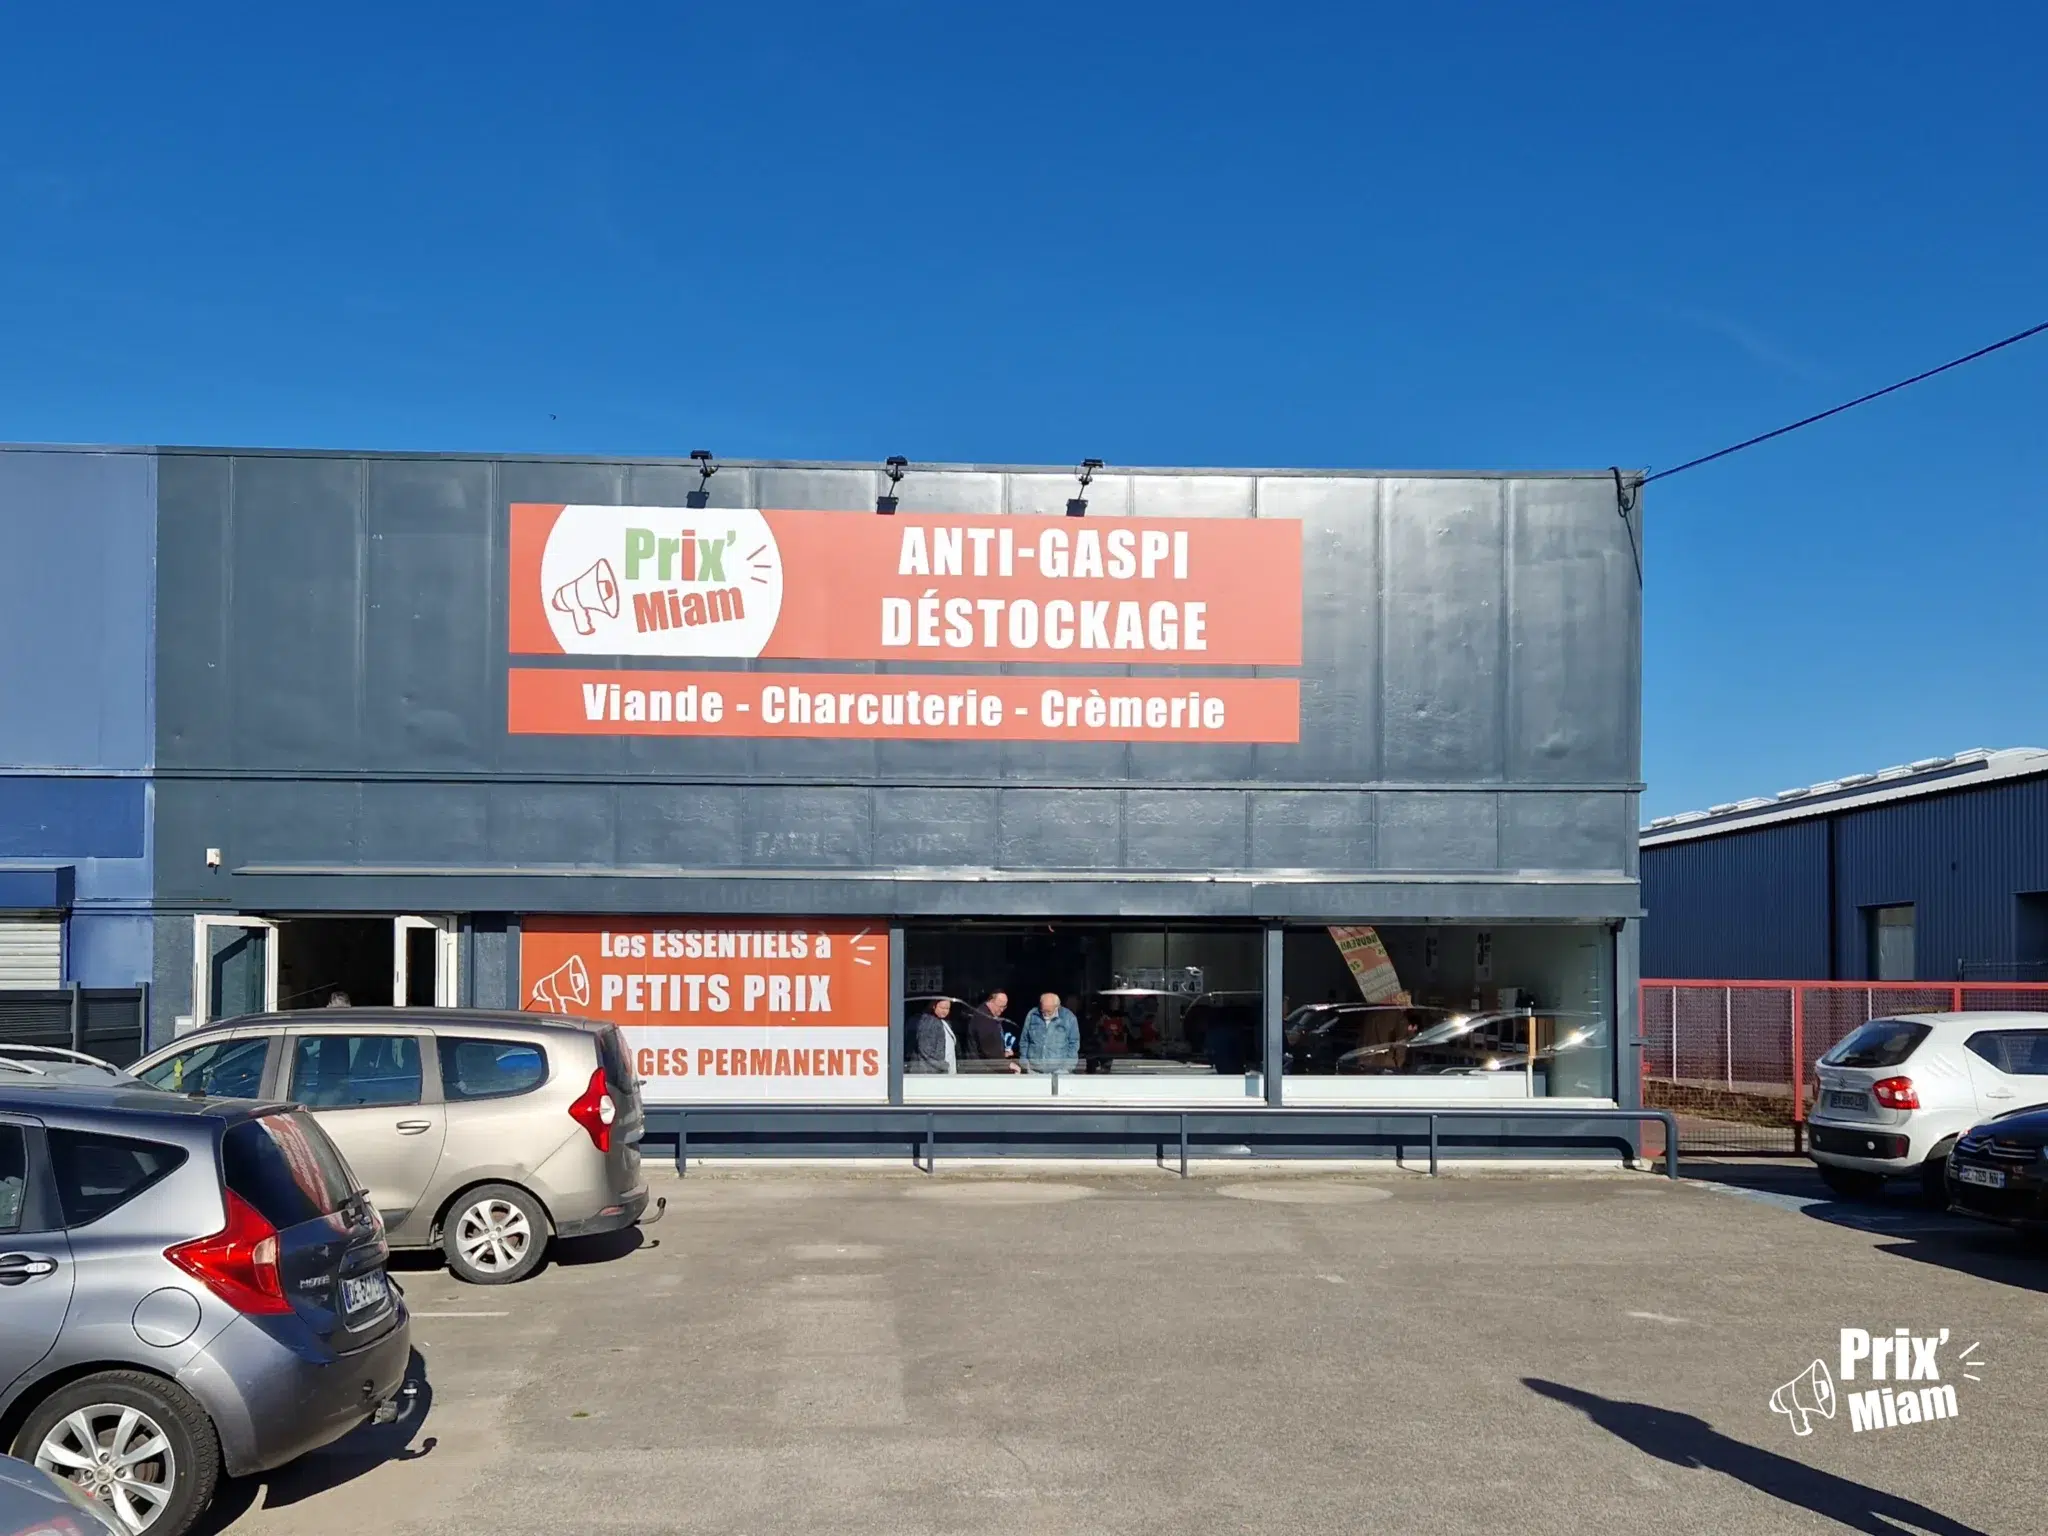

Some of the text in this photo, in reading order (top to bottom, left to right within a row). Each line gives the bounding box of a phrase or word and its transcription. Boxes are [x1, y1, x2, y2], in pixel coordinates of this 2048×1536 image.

[898, 526, 1188, 579] ANTI-GASPI
[632, 587, 745, 633] Miam
[881, 589, 1207, 650] DÉSTOCKAGE
[582, 683, 724, 722] Viande
[761, 686, 1002, 727] Charcuterie
[1041, 688, 1225, 729] Crèmerie
[601, 930, 832, 959] Les ESSENTIELS à
[601, 974, 832, 1012] PETITS PRIX
[629, 1047, 880, 1077] GES PERMANENTS
